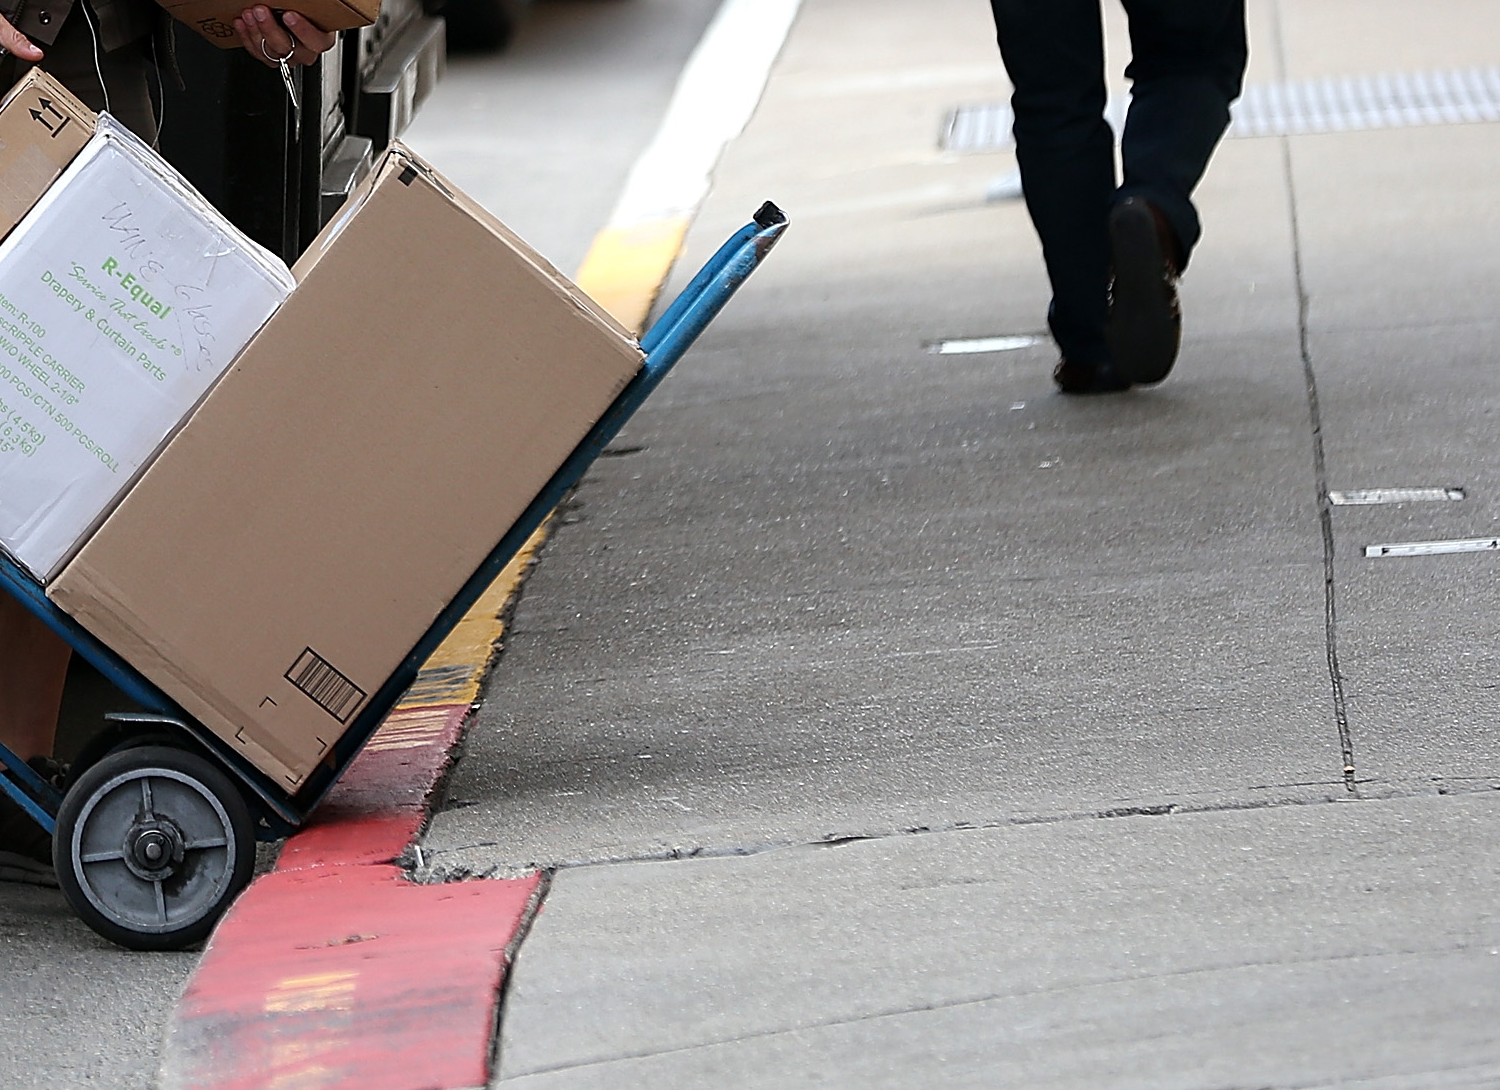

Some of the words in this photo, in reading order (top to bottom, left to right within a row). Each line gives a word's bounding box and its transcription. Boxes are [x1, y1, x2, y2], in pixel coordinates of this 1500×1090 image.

[101, 256, 174, 320] R-Equal
[17, 312, 46, 338] R-100
[40, 270, 86, 312] Drapery
[84, 308, 96, 321] &
[96, 318, 136, 356] Curtain
[136, 352, 167, 381] Parts
[108, 298, 137, 322] That
[18, 353, 51, 386] WHEEL
[42, 354, 85, 393] CARRIER
[72, 427, 119, 472] PCS/ROLL
